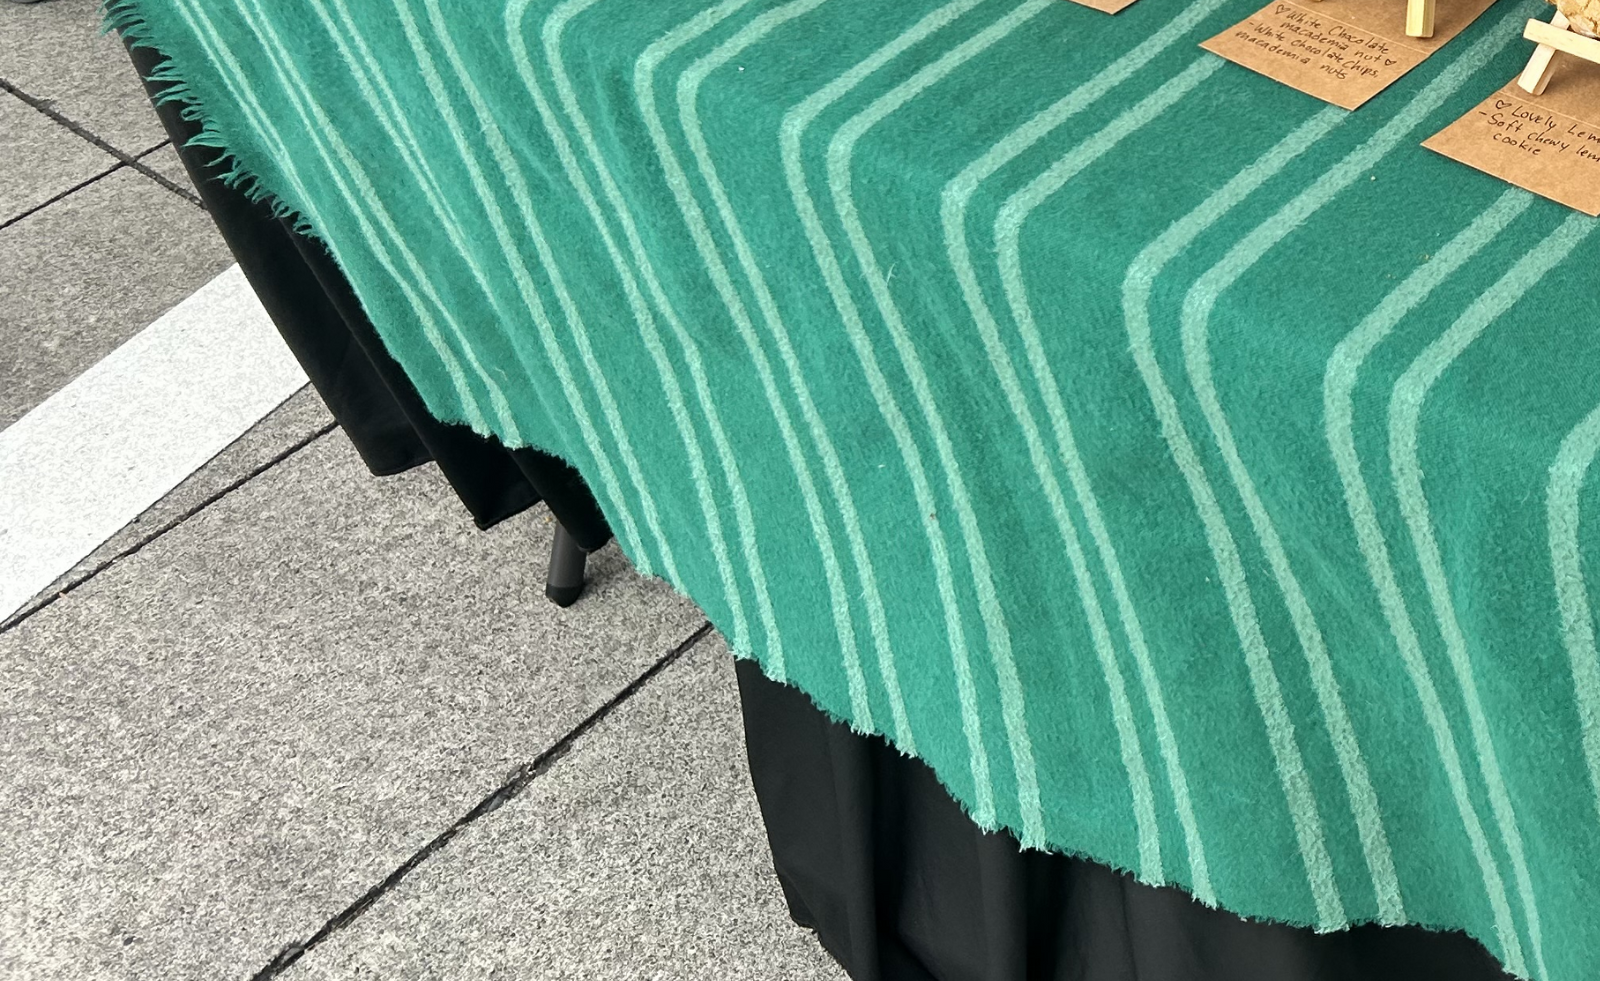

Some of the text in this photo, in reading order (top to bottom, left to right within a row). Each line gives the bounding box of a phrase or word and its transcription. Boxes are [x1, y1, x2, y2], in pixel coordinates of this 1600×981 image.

[1287, 8, 1390, 55] White Chocolate
[1354, 49, 1383, 62] nut
[1319, 64, 1348, 80] nuts
[1511, 105, 1556, 130] Lovely
[1492, 132, 1542, 156] cookie
[1528, 130, 1570, 152] chewy
